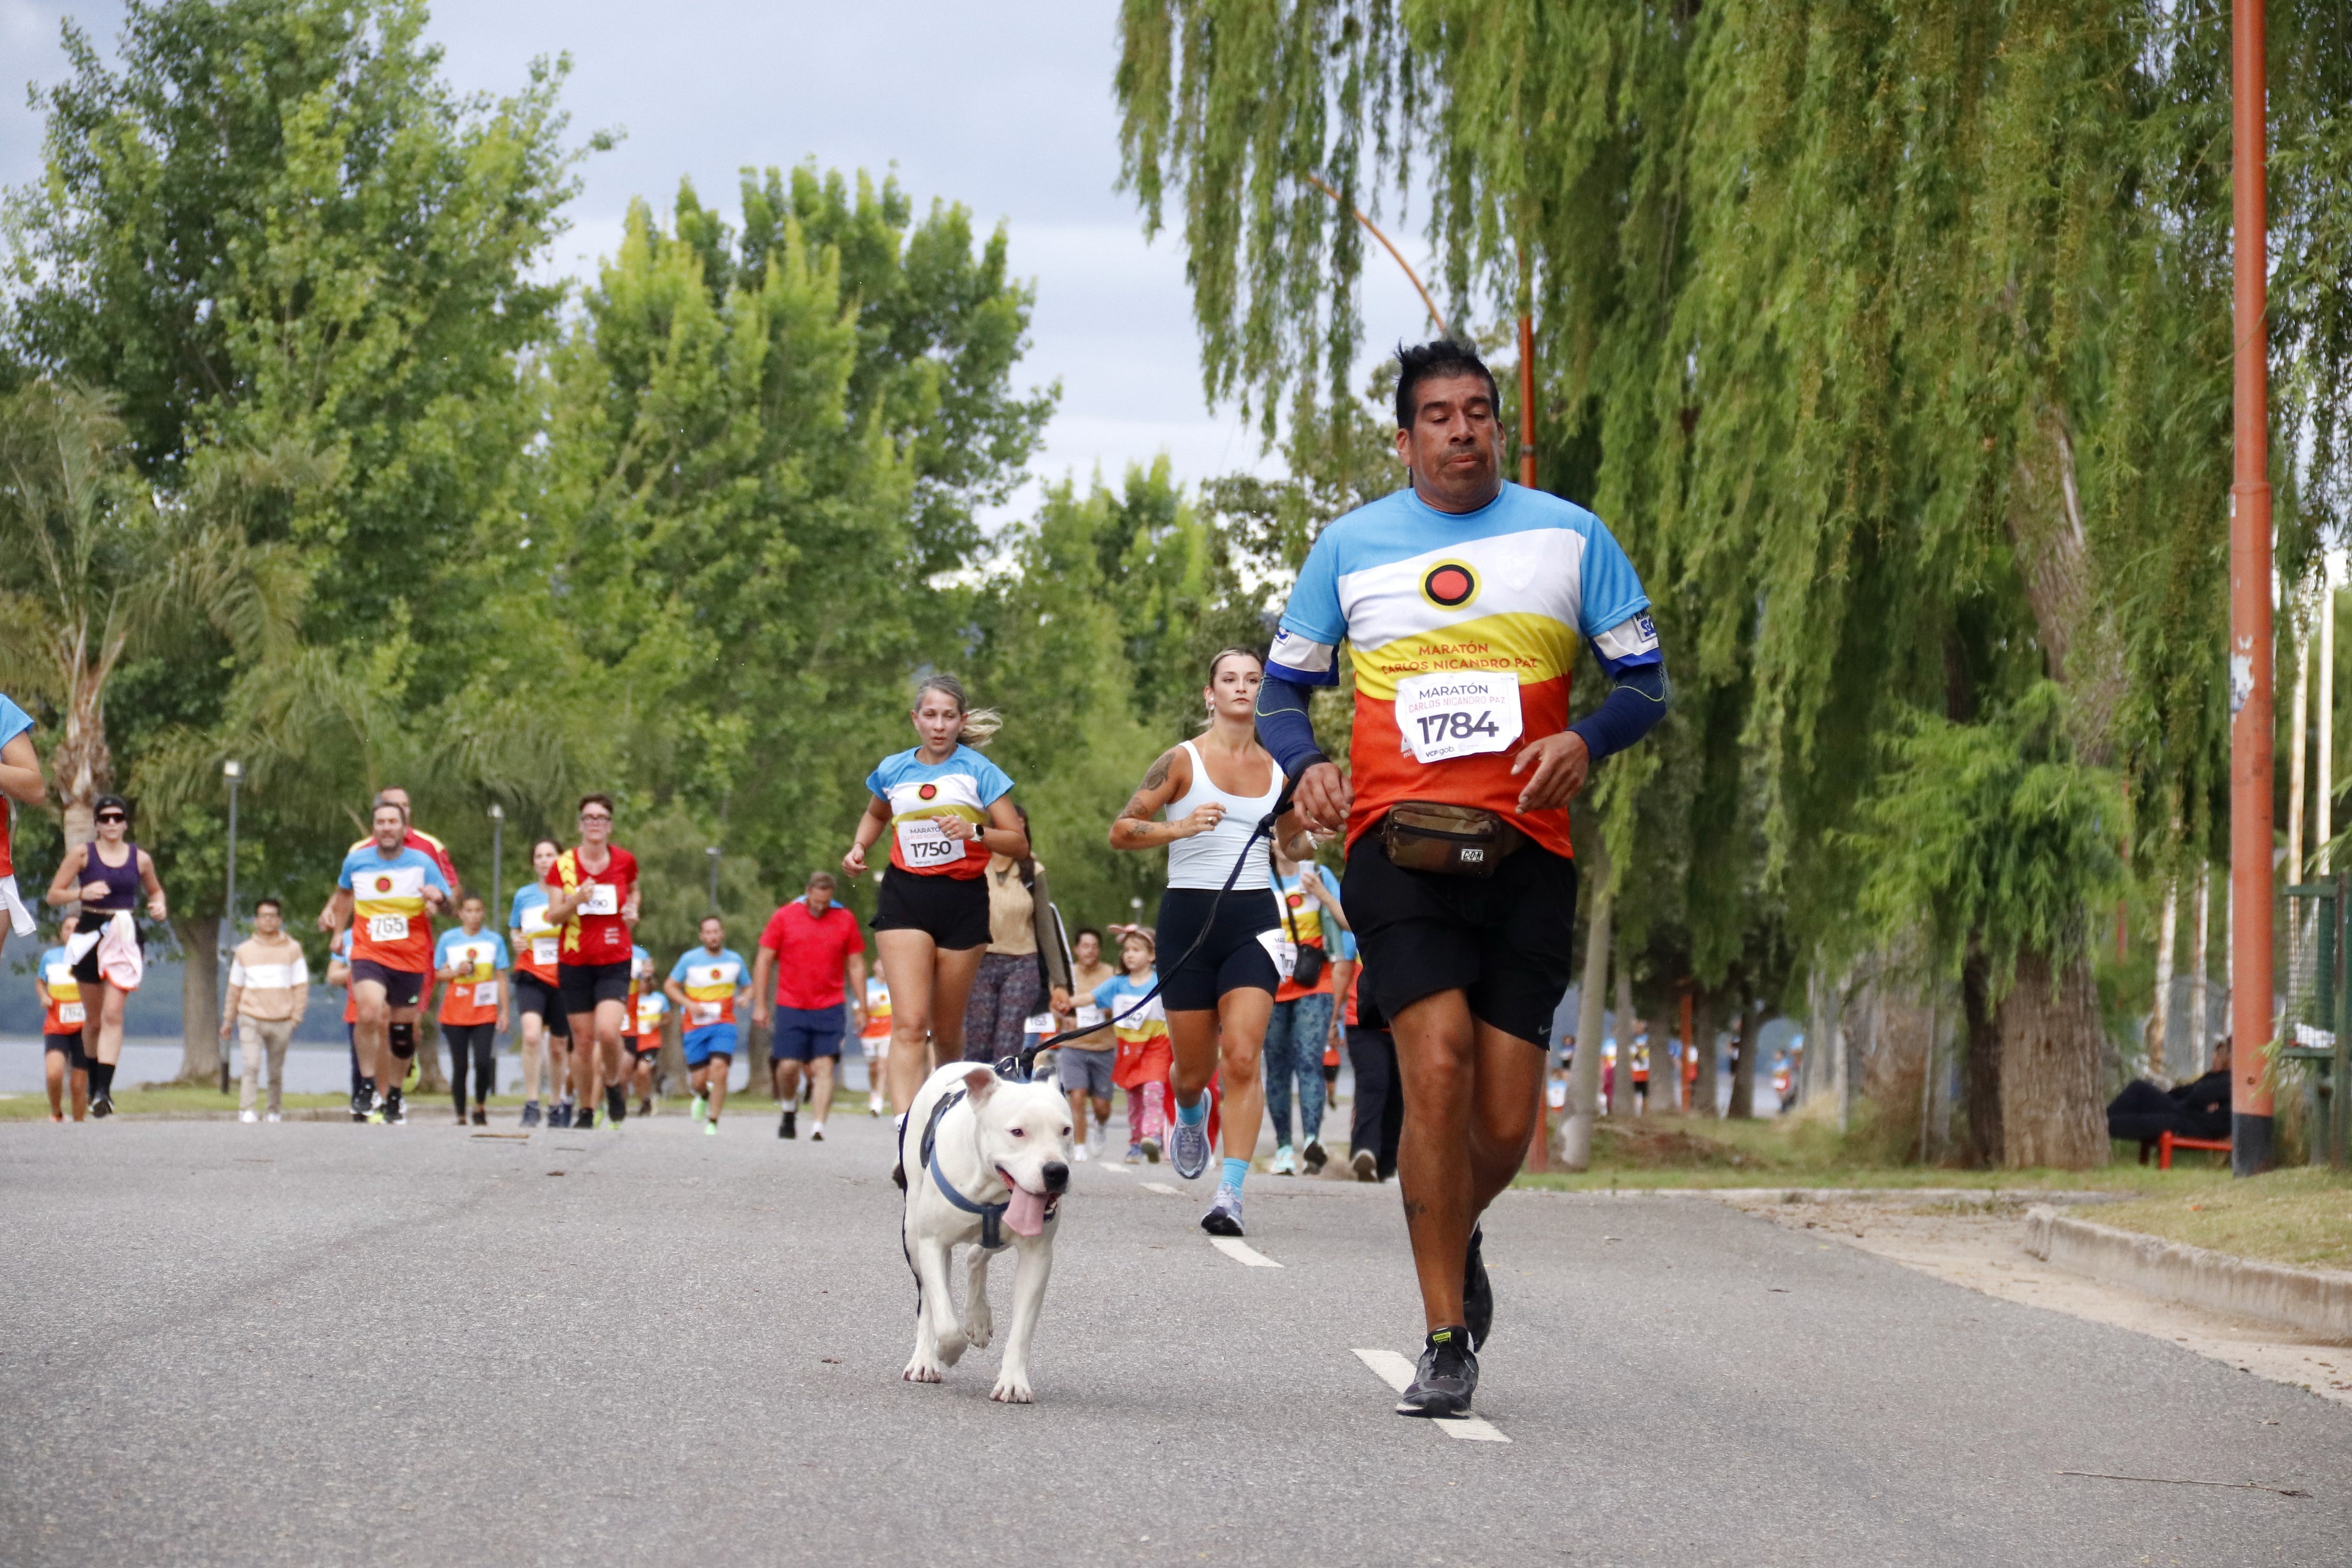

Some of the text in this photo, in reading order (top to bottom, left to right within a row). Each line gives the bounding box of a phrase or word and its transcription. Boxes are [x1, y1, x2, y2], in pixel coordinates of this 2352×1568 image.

[1419, 641, 1488, 656] MARATÓN
[1381, 661, 1429, 675] CARLOS
[1433, 658, 1510, 670] NICANDRO
[1419, 682, 1489, 700] MARATÓN
[1409, 699, 1440, 713] CARLOS
[1443, 696, 1486, 706] NICANDRO
[1416, 710, 1500, 745] 1784
[910, 840, 951, 858] 1750
[376, 917, 404, 934] 765
